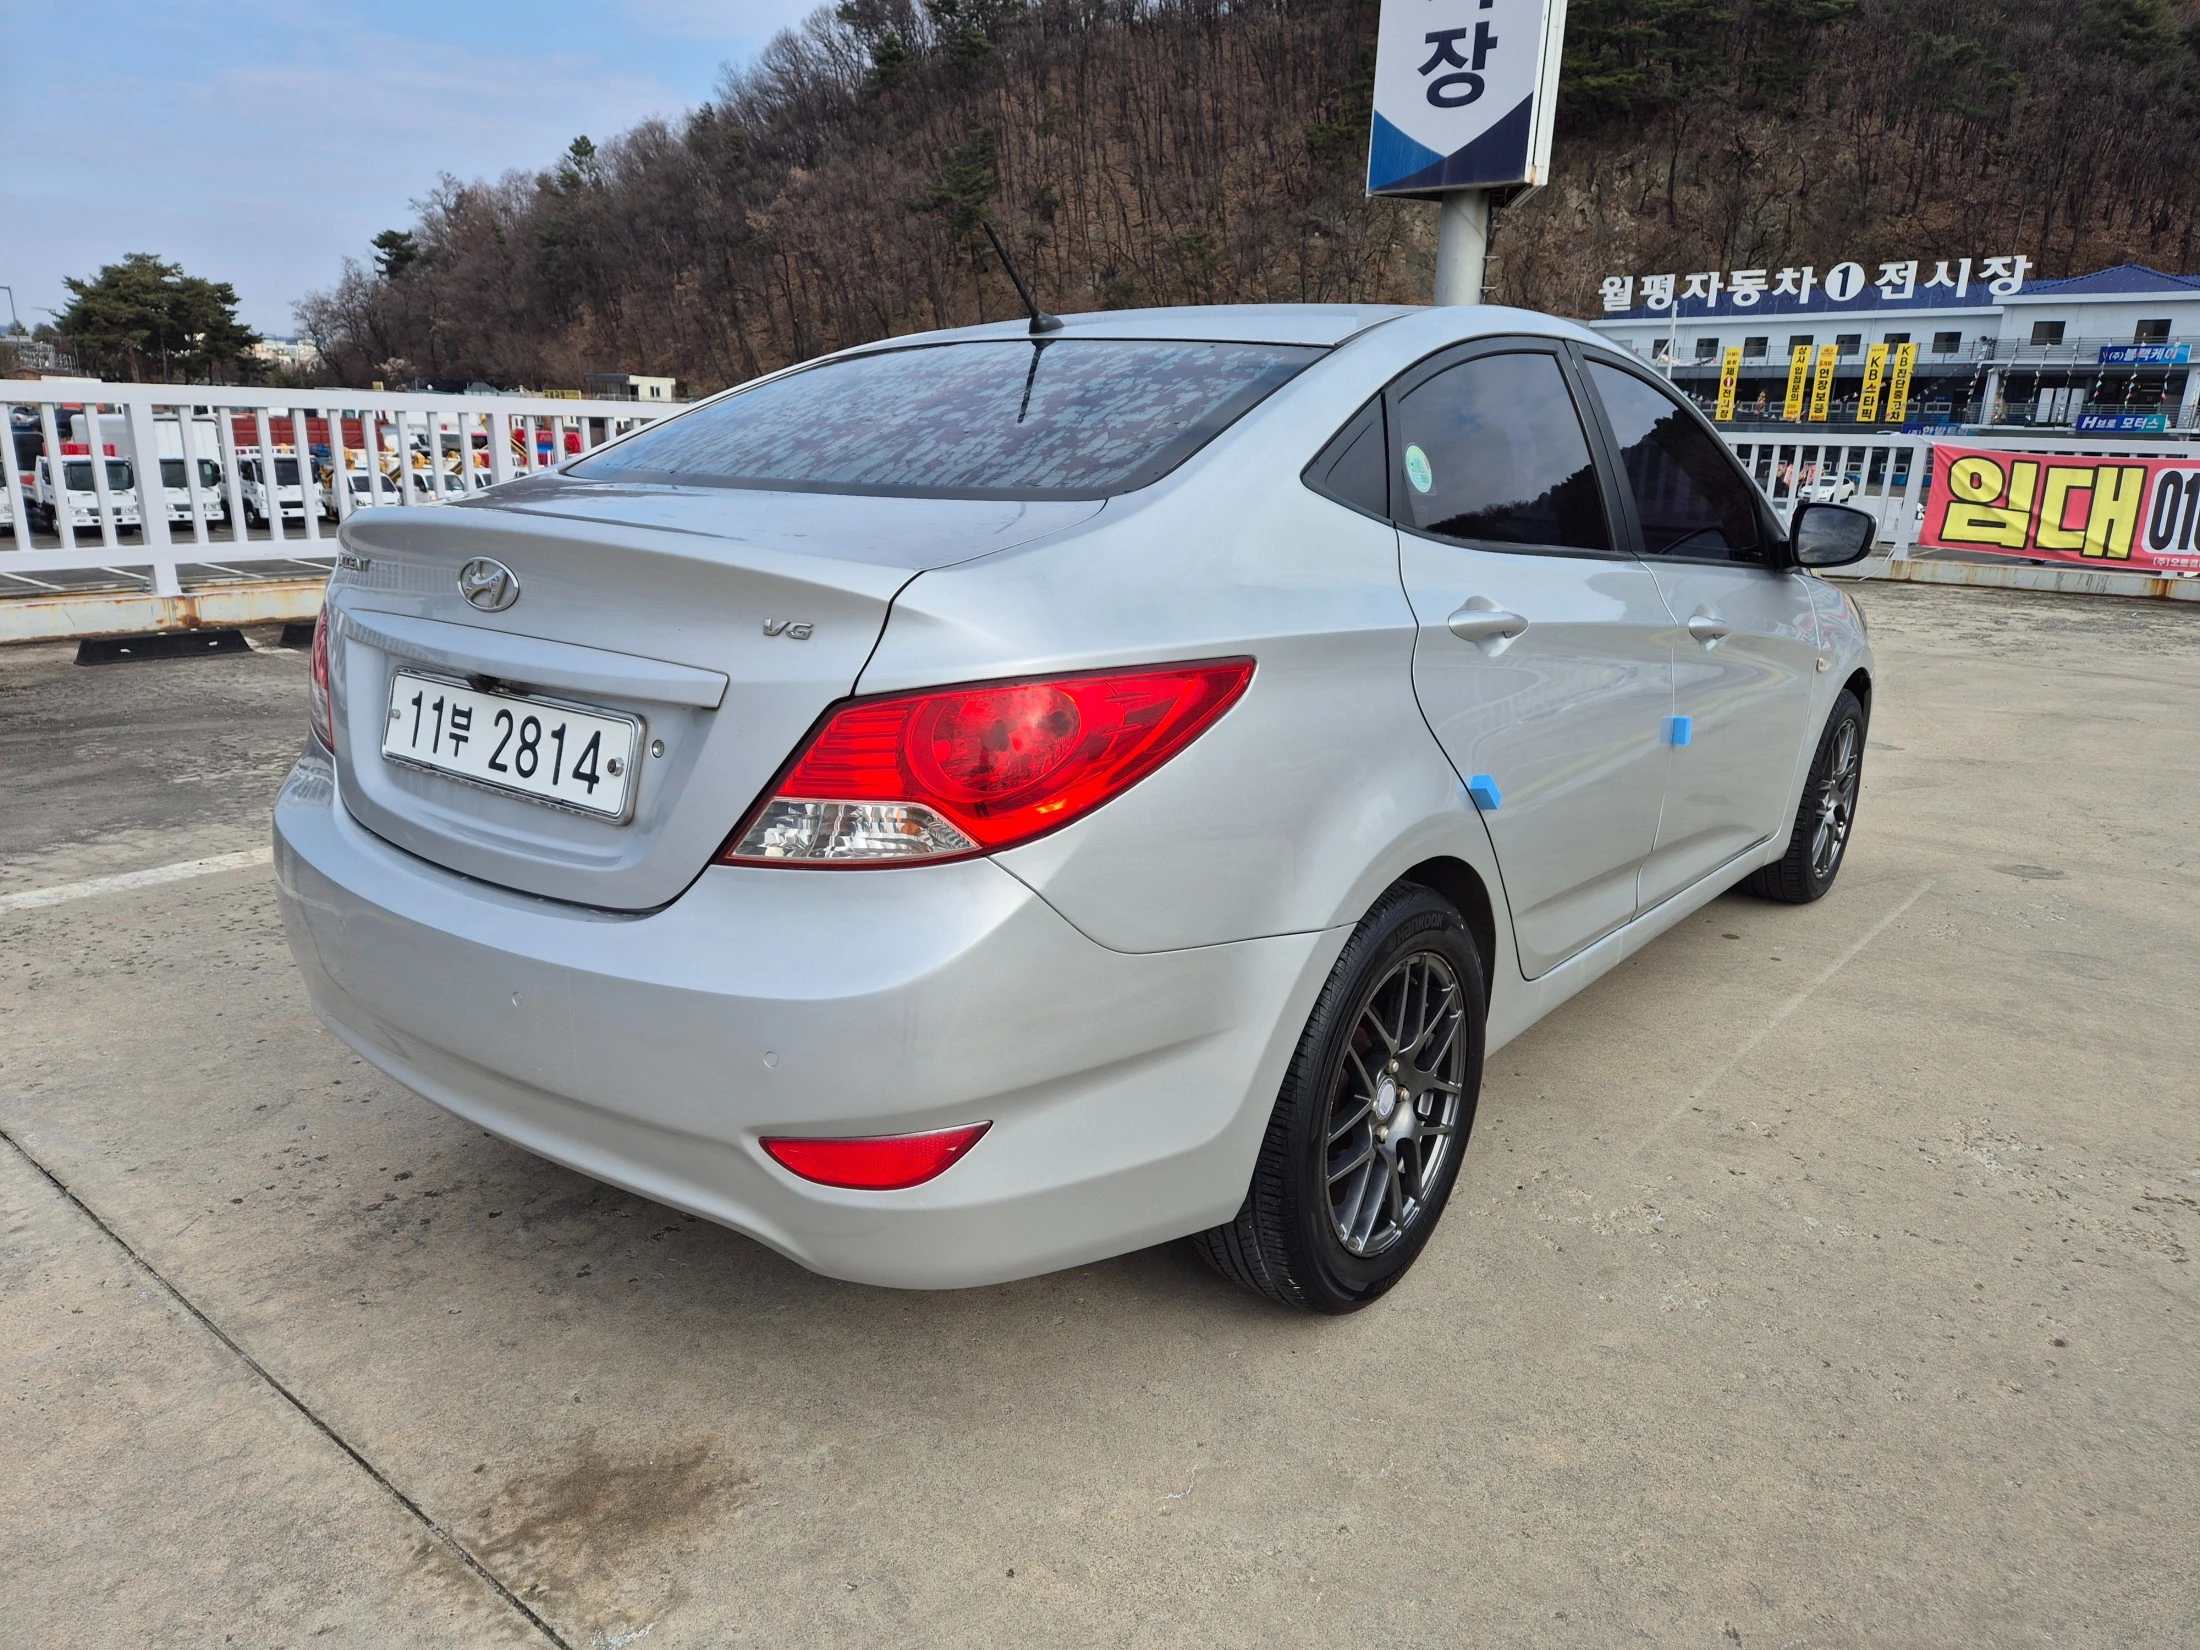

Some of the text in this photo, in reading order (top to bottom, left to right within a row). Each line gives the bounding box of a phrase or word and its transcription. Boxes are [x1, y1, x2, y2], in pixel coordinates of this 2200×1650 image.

[1417, 0, 1498, 108] 장
[1940, 456, 2200, 561] 임대 01
[763, 617, 814, 640] VG
[411, 690, 602, 796] 11부 2814
